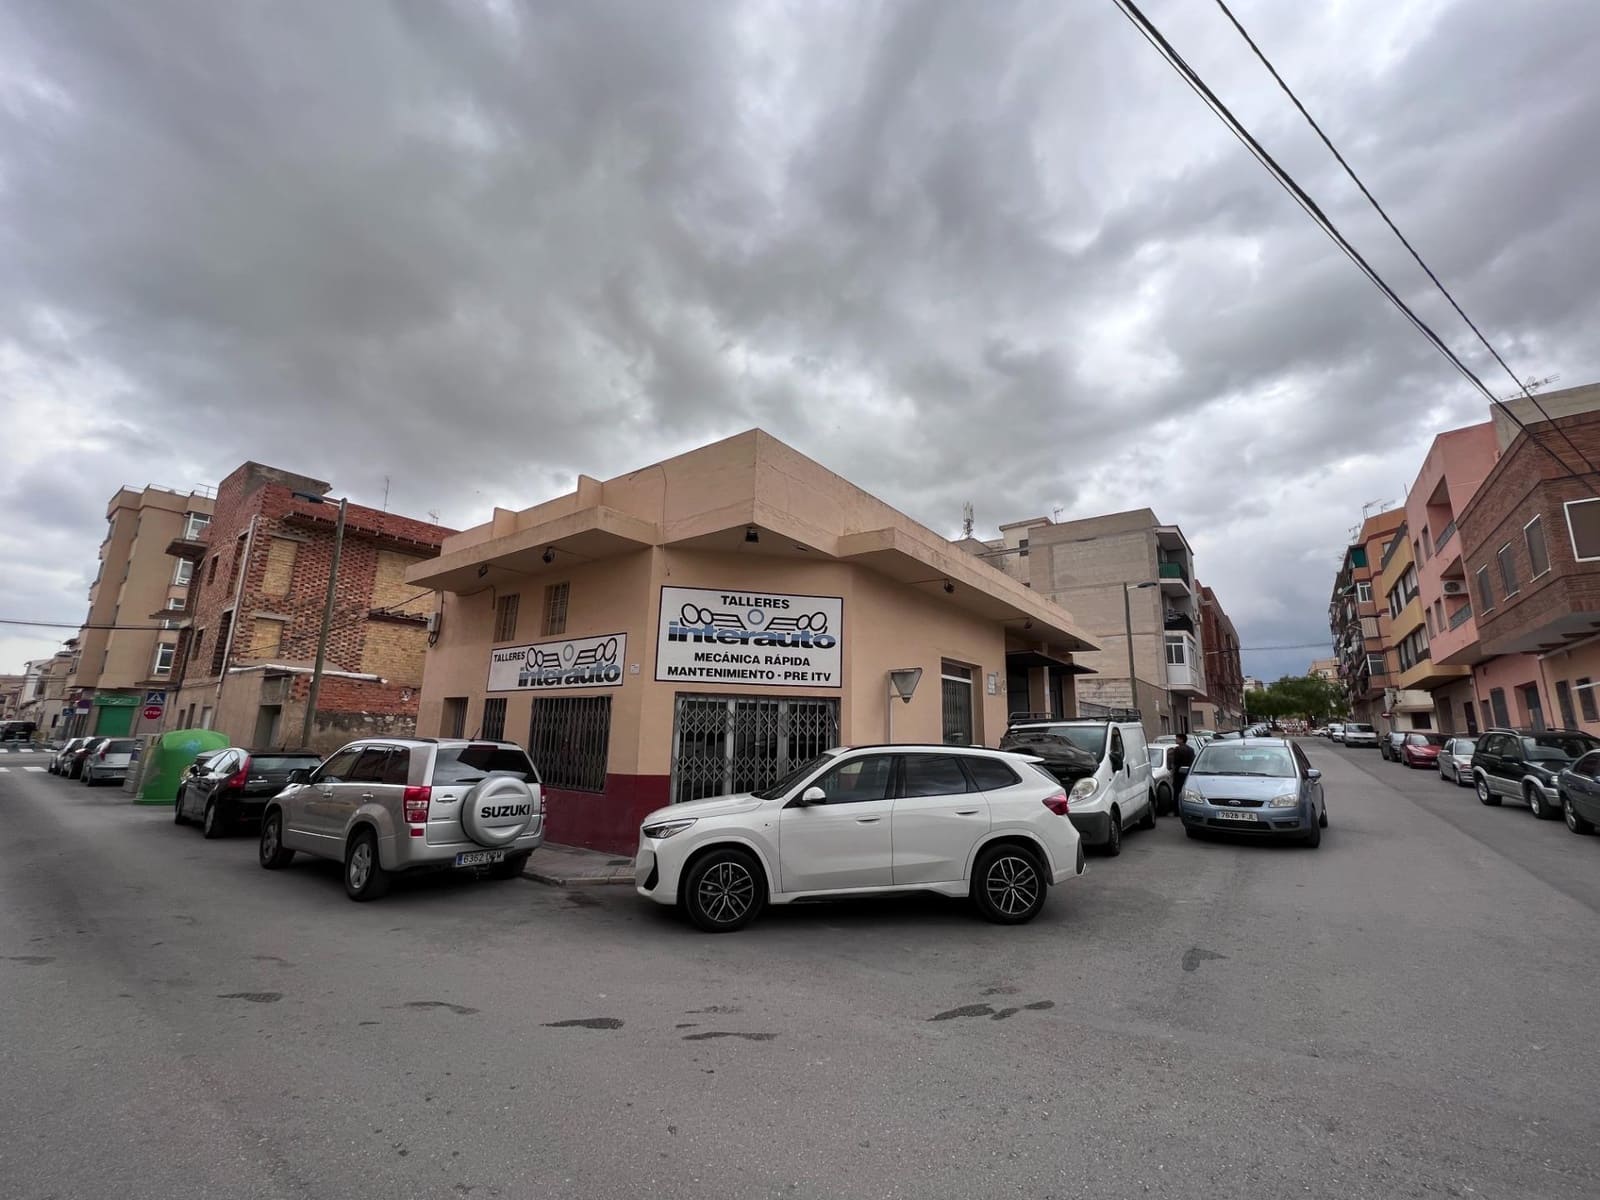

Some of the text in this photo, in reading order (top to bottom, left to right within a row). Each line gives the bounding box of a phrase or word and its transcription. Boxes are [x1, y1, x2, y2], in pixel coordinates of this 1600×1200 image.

[721, 595, 790, 609] TALLERES
[668, 620, 836, 649] interauto
[493, 651, 526, 663] TALLERES
[694, 651, 811, 667] MECÁNICA RÁPIDA
[518, 662, 621, 687] interauto
[667, 666, 775, 680] MANTENIMIENTO
[783, 671, 808, 681] PRE
[811, 672, 832, 682] ITV
[480, 804, 530, 818] SUZUKI
